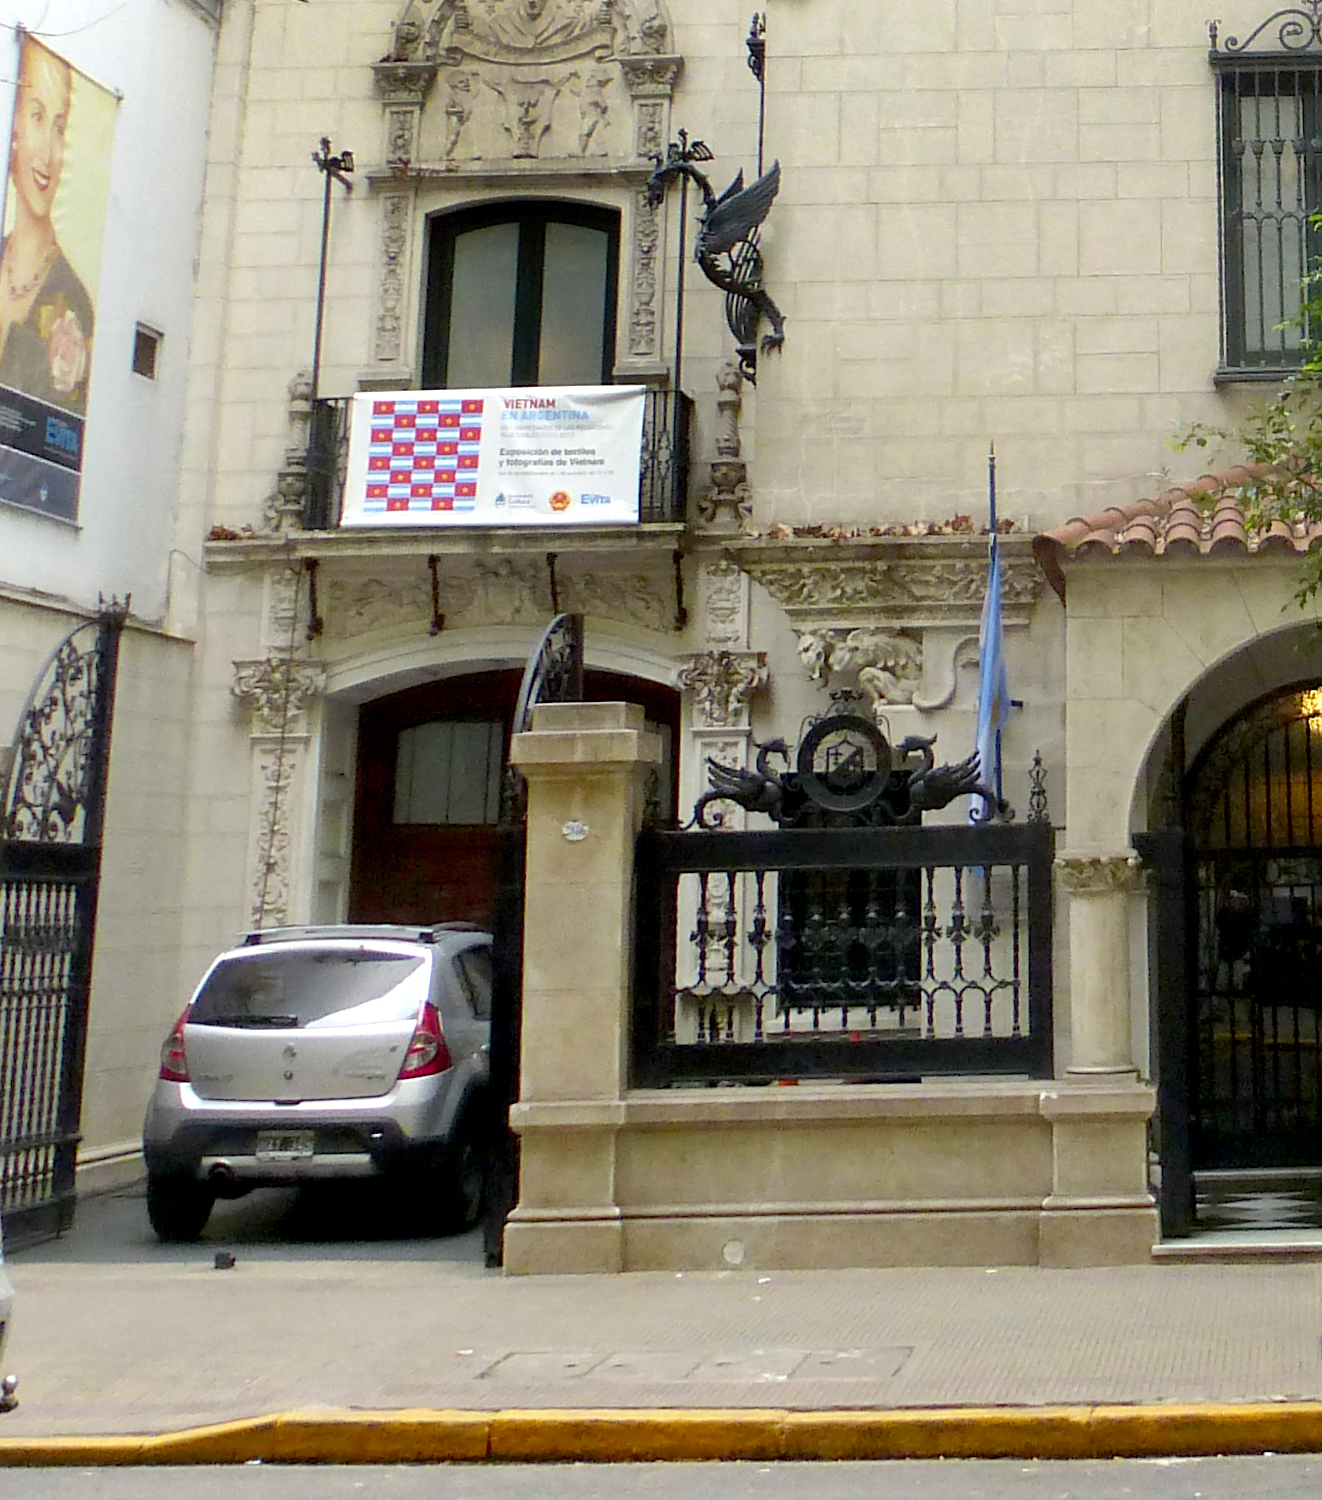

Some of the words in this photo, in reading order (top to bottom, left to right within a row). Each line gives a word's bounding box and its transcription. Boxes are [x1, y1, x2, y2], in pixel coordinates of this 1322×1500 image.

[503, 398, 556, 409] VIETNAM
[501, 410, 517, 421] EN
[521, 410, 590, 421] ARGENTINA
[499, 447, 549, 458] Exposición
[551, 448, 562, 456] de
[570, 458, 605, 466] Vietnam
